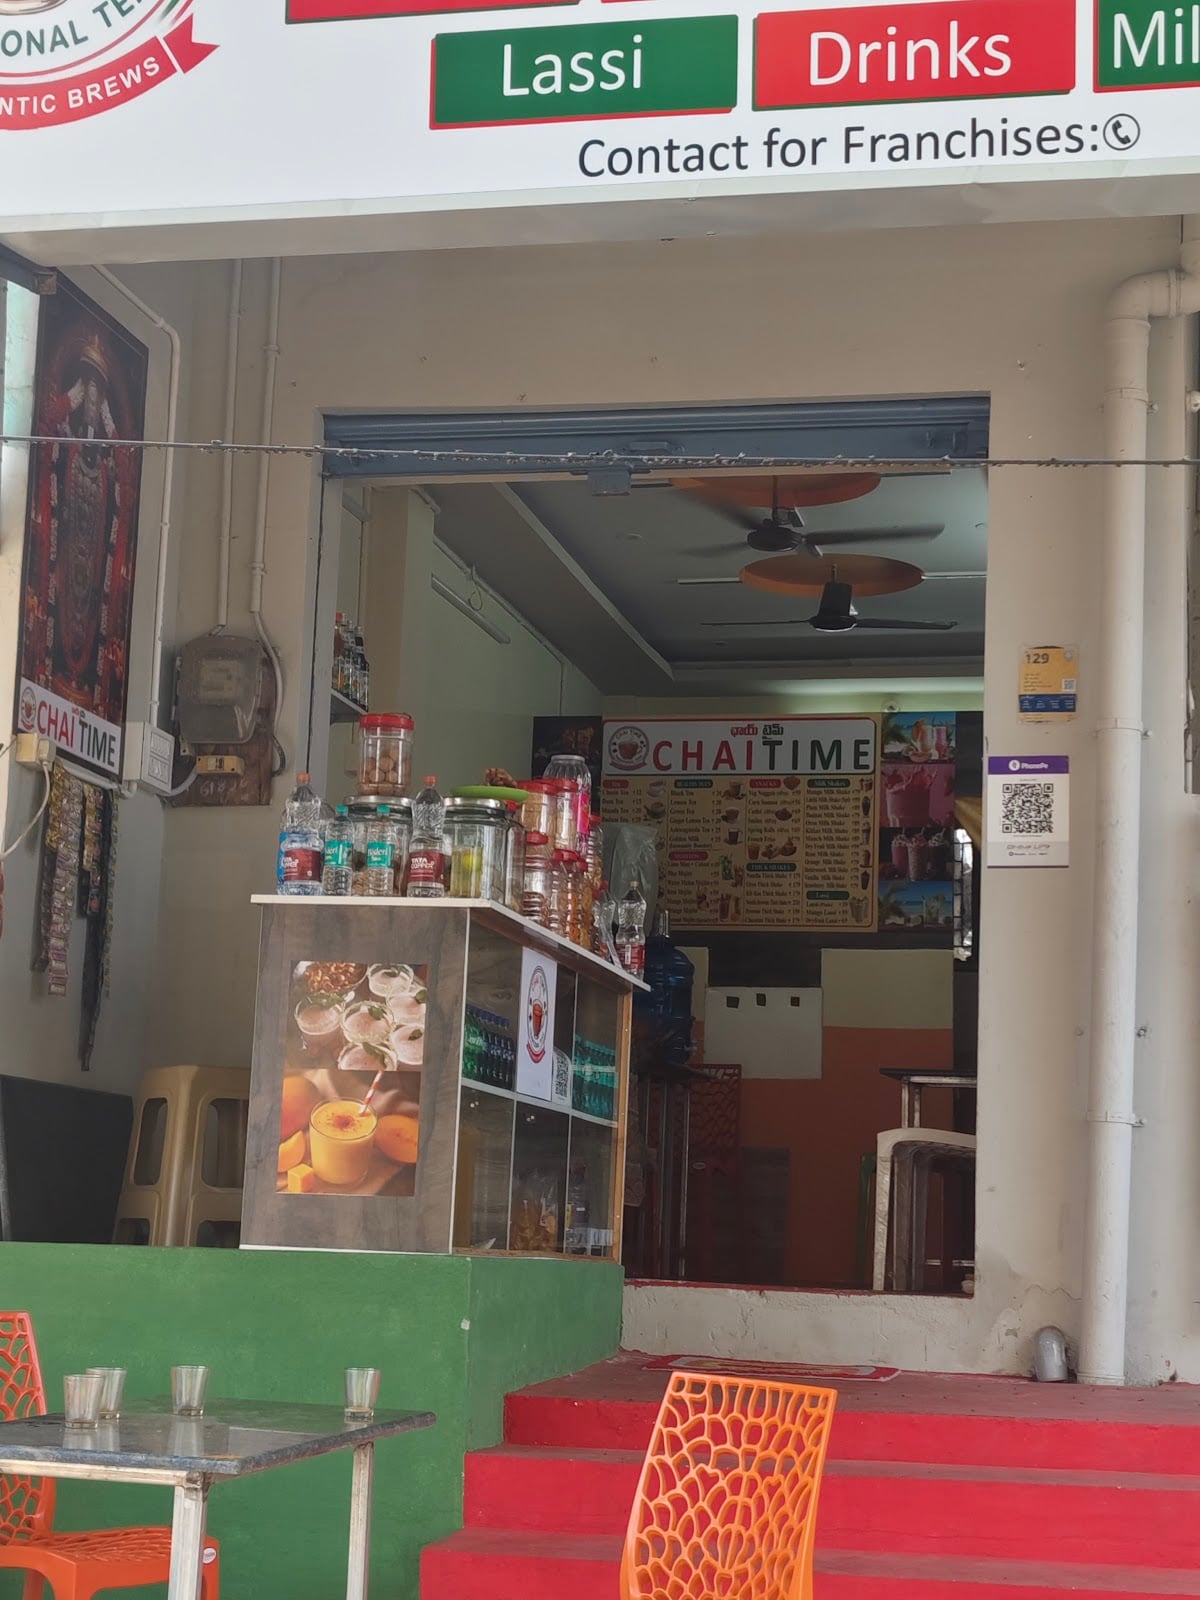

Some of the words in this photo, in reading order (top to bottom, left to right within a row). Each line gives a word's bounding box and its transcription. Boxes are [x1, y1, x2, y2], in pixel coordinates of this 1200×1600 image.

[67, 56, 161, 109] BREWS
[502, 34, 643, 97] Lassi
[808, 20, 1012, 87] Drinks
[578, 136, 749, 178] Contact
[763, 127, 827, 169] for
[843, 117, 1100, 164] Franchises:
[1025, 652, 1050, 665] 129
[37, 700, 76, 749] CHAI
[78, 718, 116, 768] TIME
